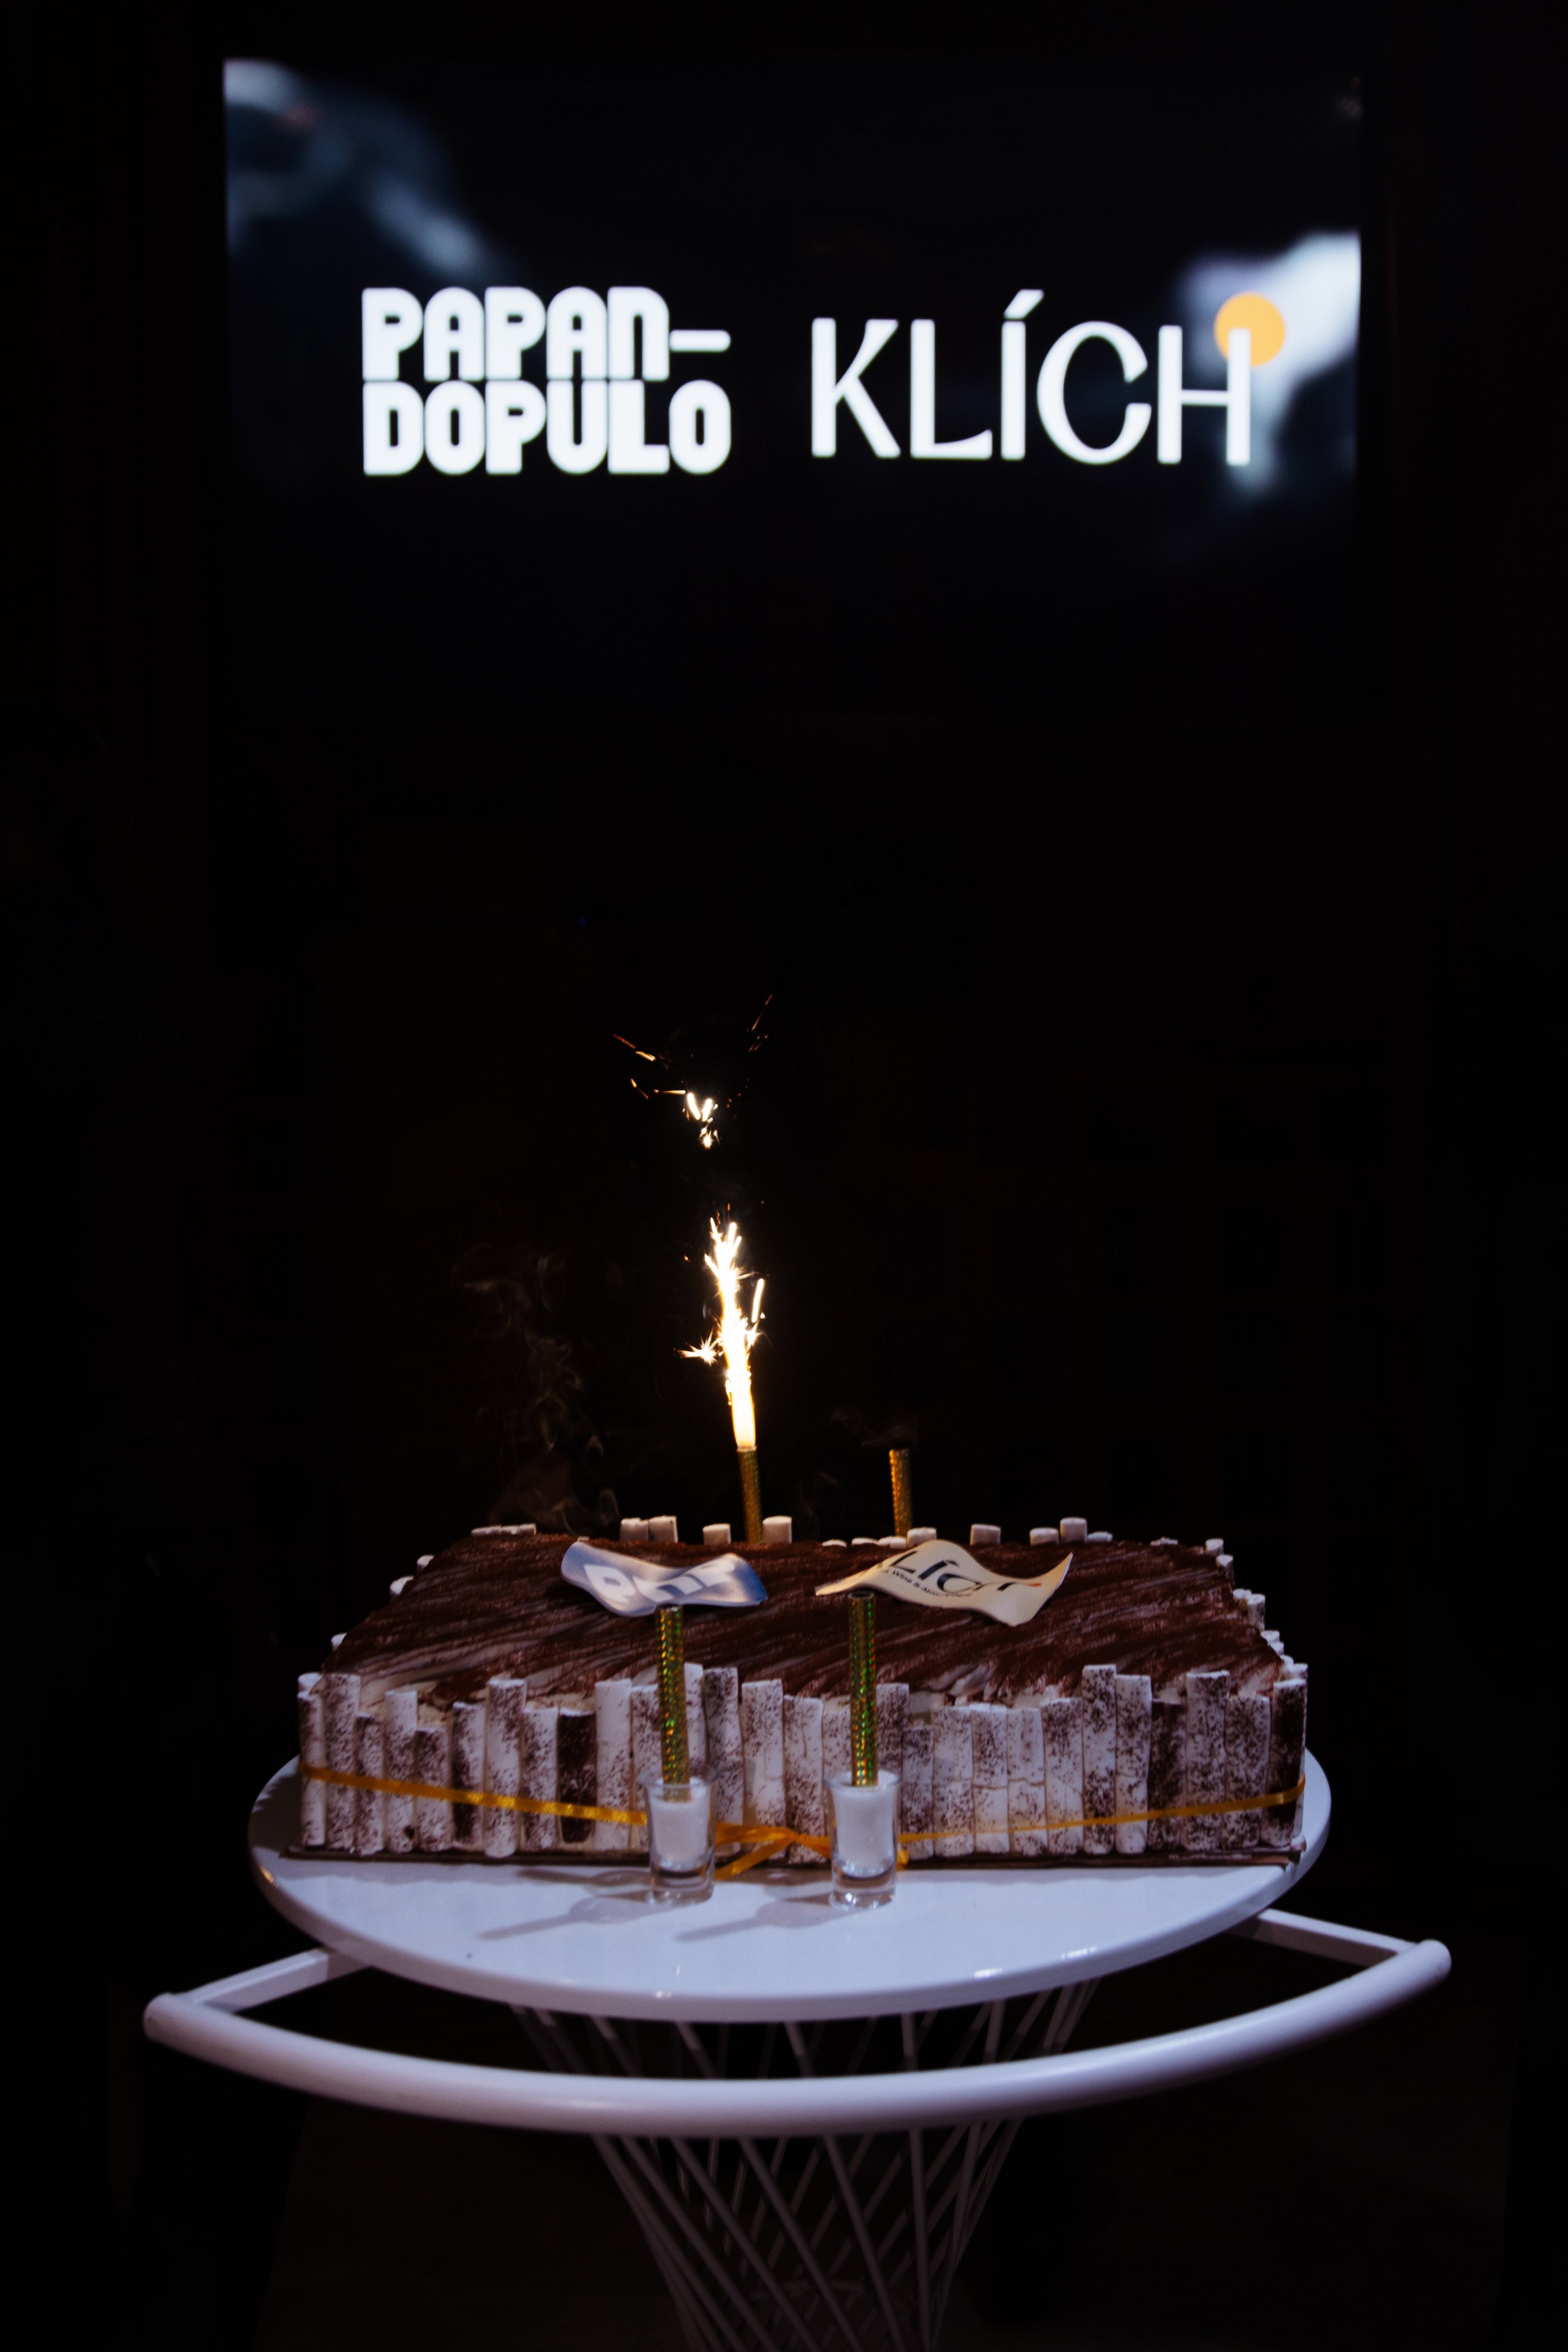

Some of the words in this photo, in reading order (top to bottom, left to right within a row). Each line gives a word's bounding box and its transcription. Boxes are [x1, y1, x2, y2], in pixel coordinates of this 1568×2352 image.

[361, 286, 731, 380] PAPAN-
[812, 288, 1251, 466] KLÍCH
[362, 380, 732, 475] DOPULO
